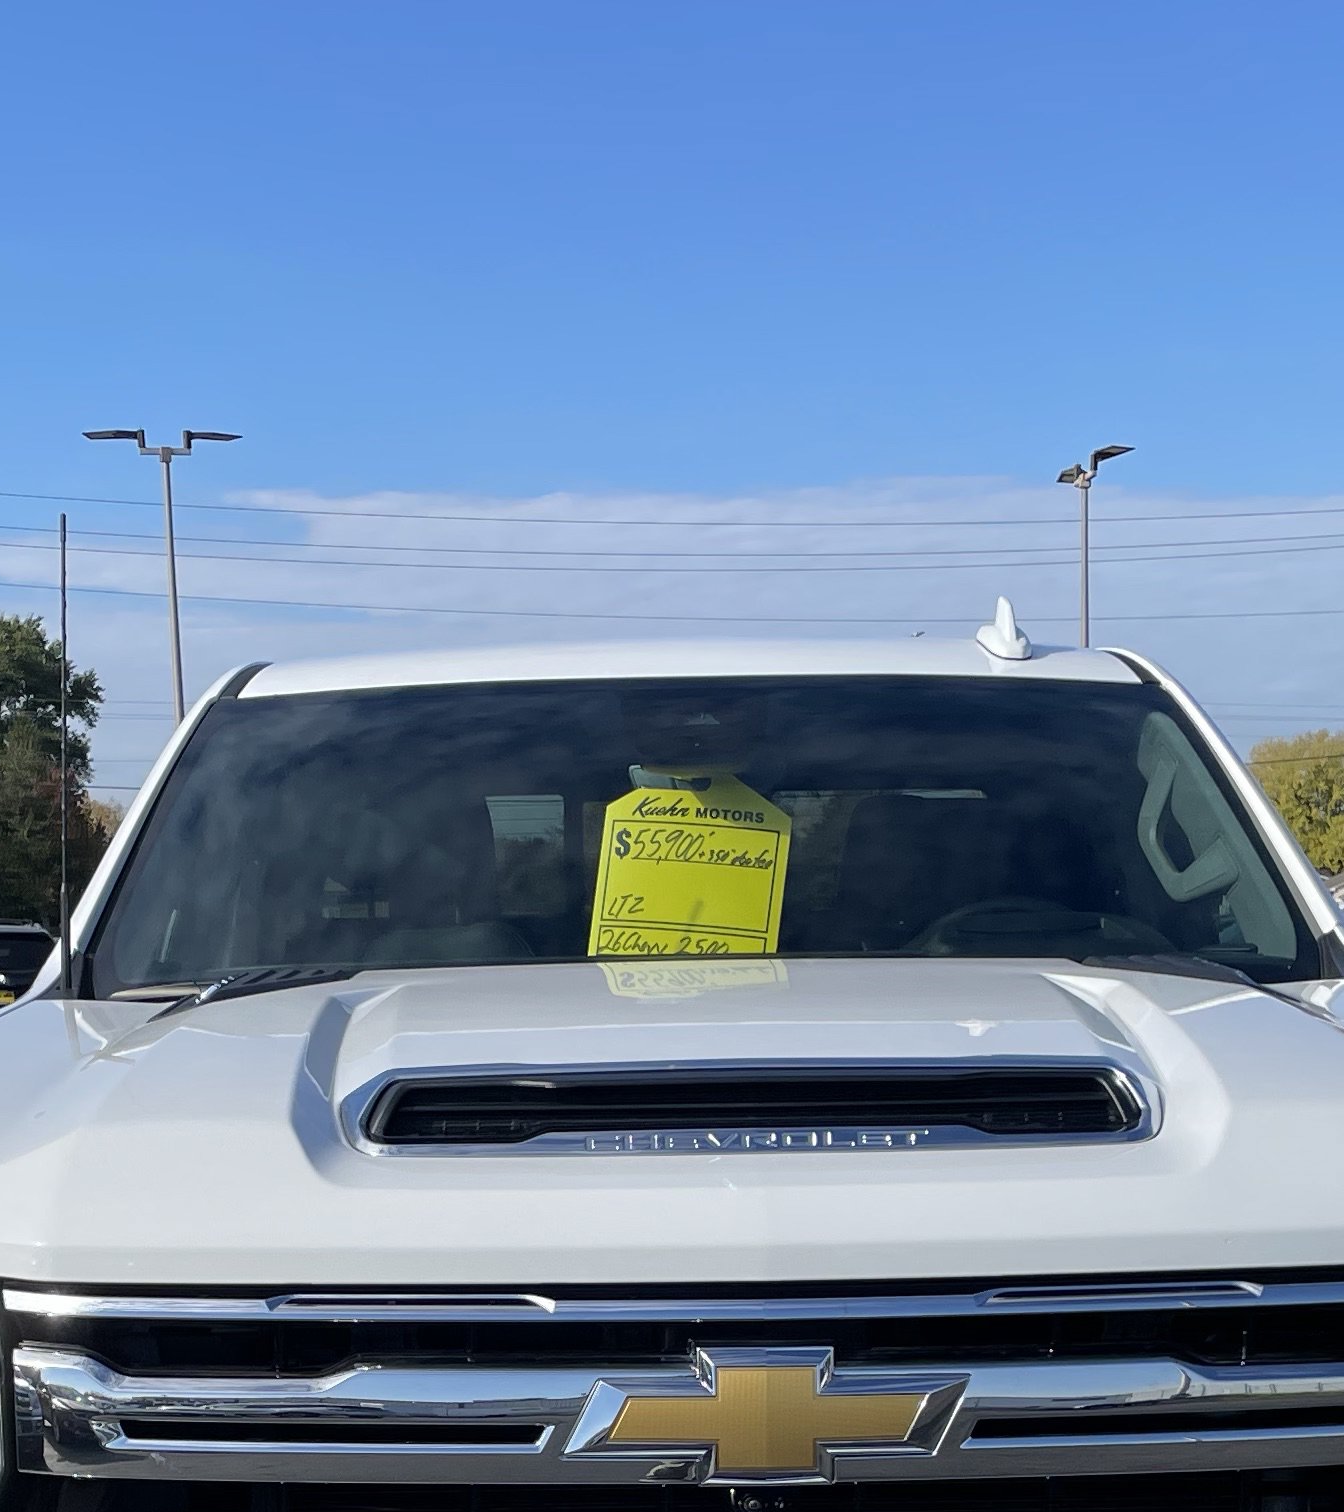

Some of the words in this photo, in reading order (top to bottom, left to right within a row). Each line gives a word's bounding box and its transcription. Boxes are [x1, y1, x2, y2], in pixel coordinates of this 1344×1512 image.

[631, 796, 690, 819] Kuehn
[695, 807, 765, 824] MOTORS
[584, 1128, 931, 1151] CHEVROLET
